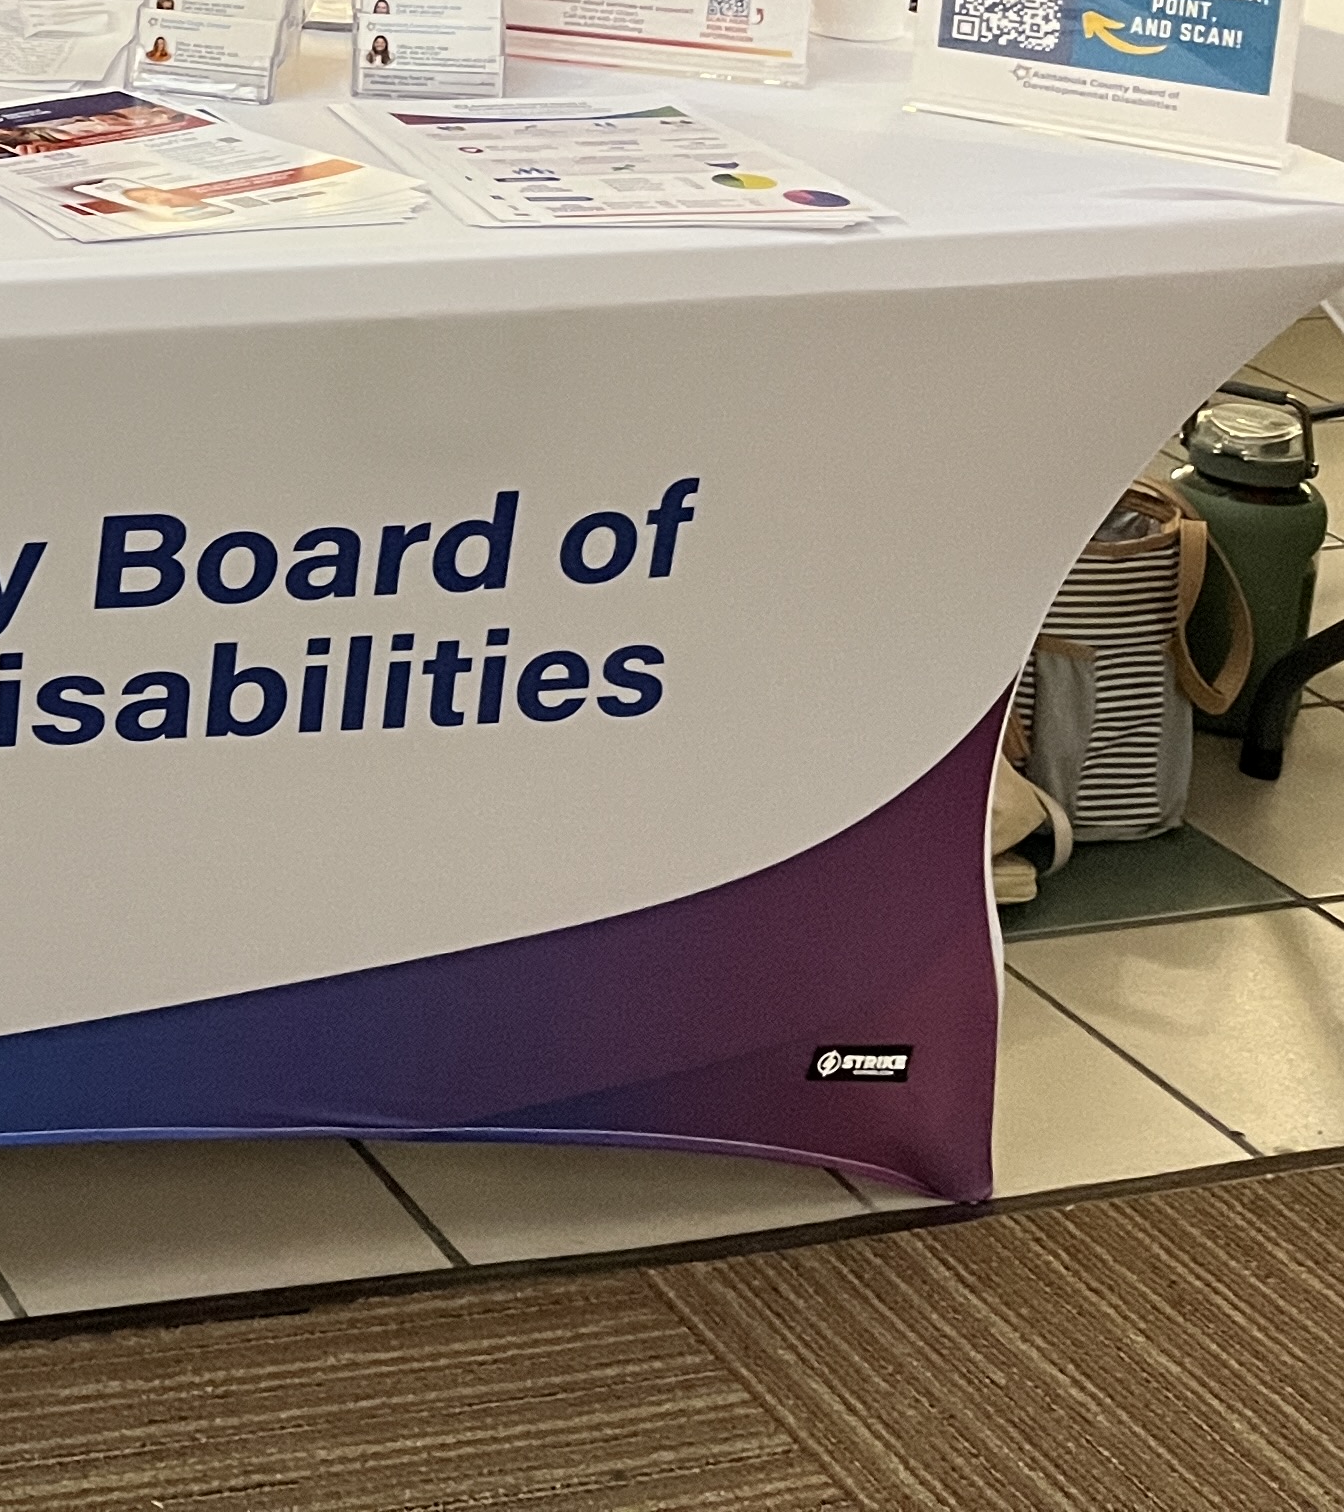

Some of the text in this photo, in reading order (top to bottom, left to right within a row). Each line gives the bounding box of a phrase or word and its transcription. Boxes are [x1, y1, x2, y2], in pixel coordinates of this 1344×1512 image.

[1130, 16, 1244, 49] AND SCAN!
[94, 491, 519, 611] Board
[559, 477, 700, 585] of
